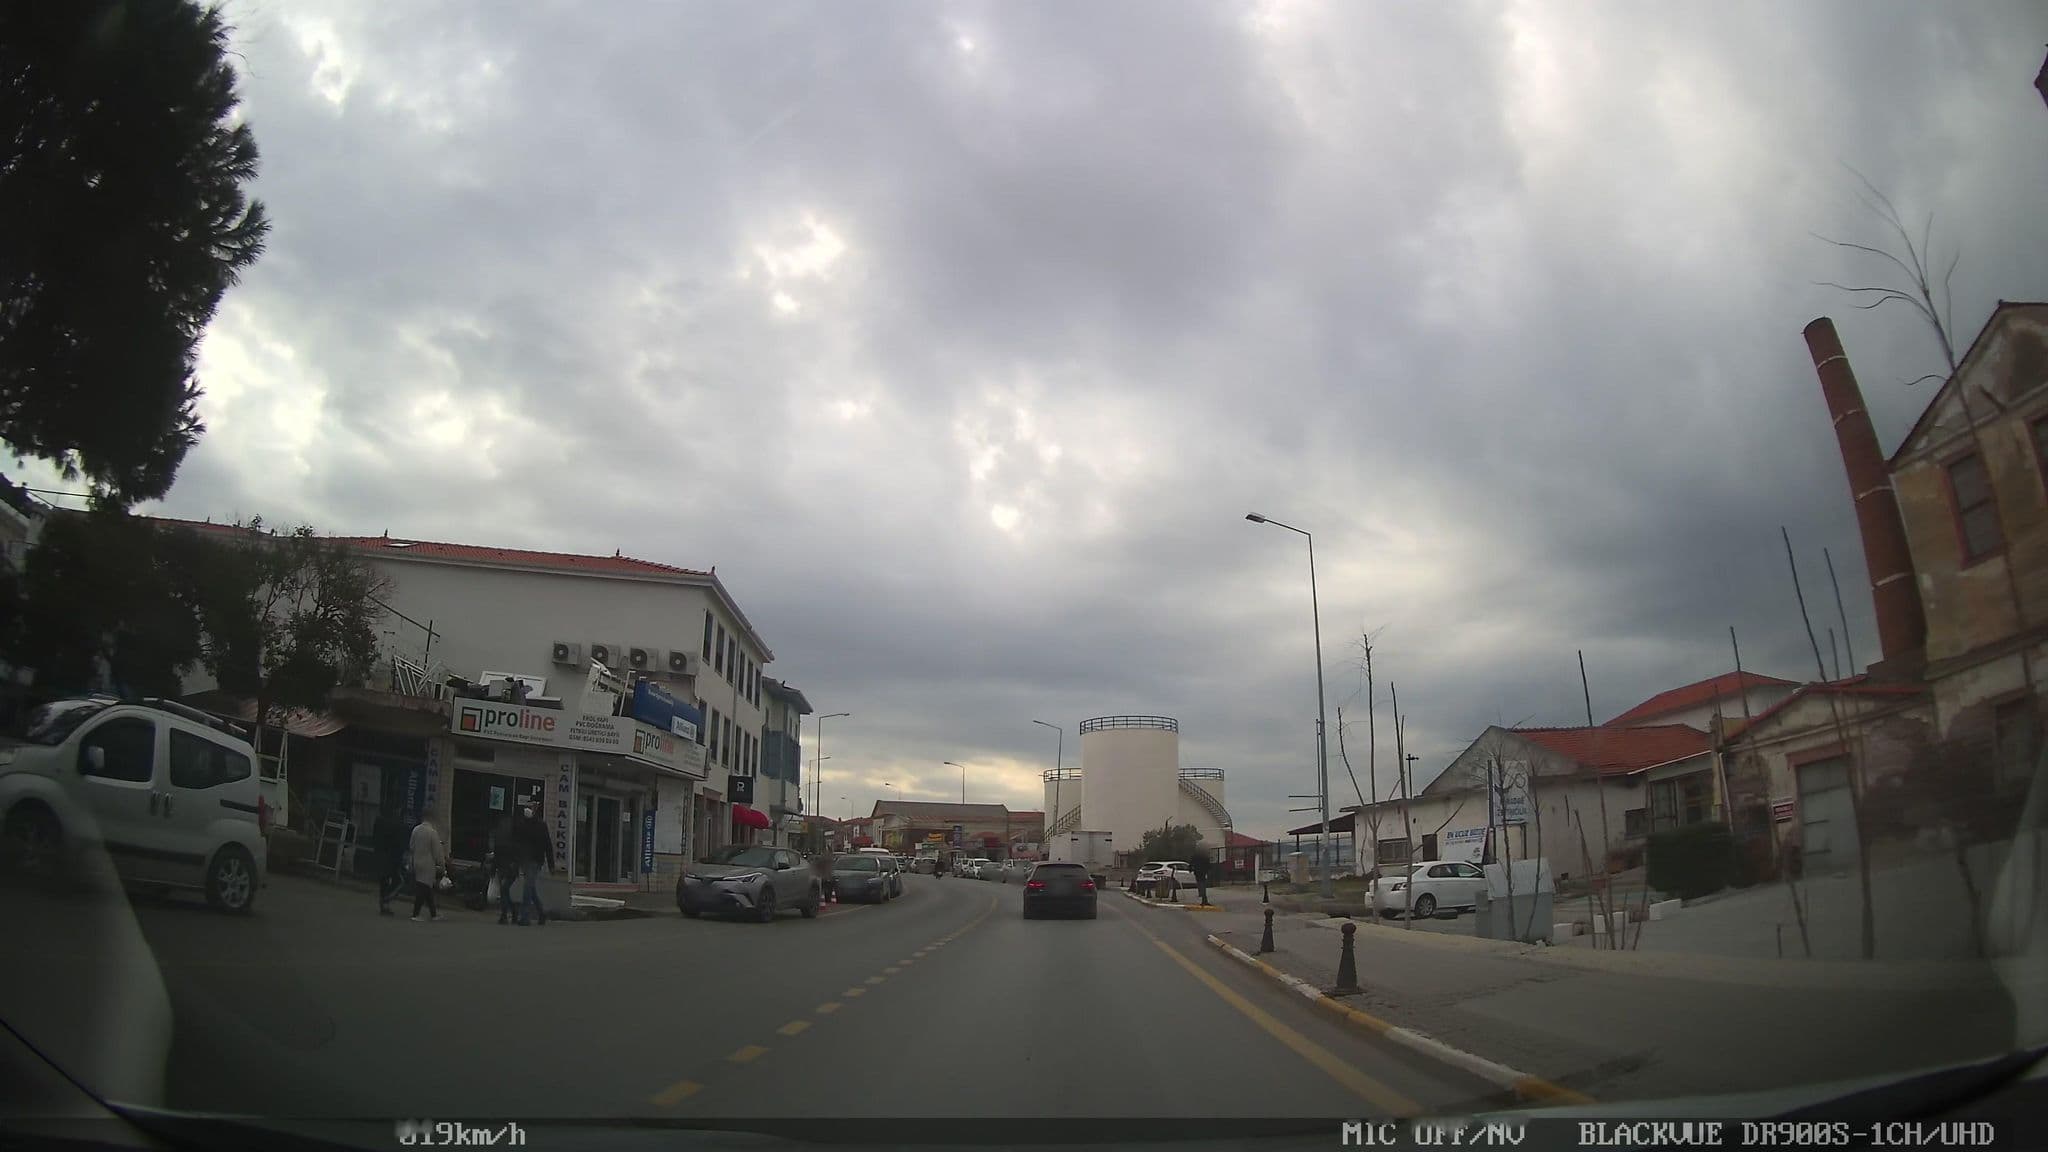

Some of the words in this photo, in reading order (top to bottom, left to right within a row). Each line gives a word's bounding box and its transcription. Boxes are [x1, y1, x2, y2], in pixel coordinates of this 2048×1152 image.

[484, 708, 555, 731] proline
[575, 720, 587, 728] PVC
[558, 764, 569, 793] CAM
[556, 800, 568, 859] BALKON
[644, 832, 652, 867] Allianz
